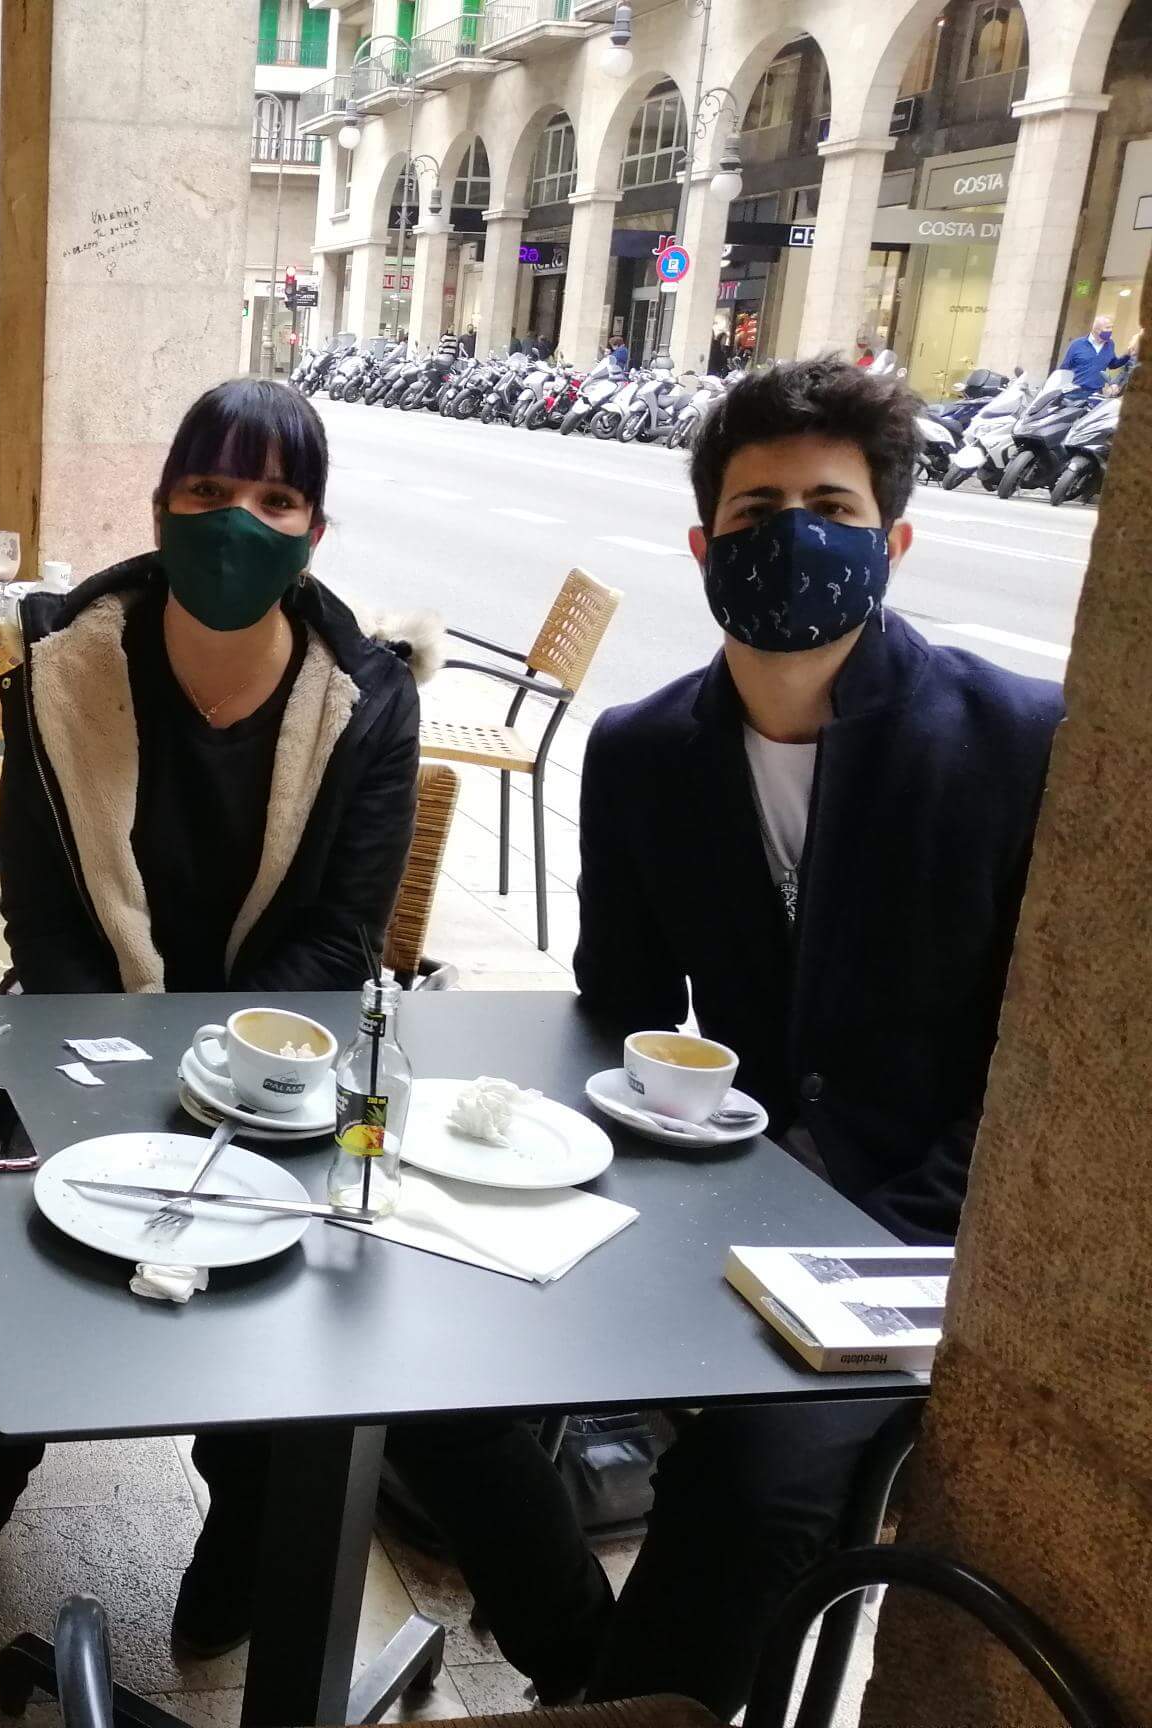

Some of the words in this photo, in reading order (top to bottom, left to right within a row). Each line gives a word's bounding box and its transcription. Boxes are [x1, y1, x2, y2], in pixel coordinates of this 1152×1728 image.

[953, 173, 1004, 195] COSTA
[918, 221, 976, 236] COSTA
[263, 1080, 304, 1093] PALMA
